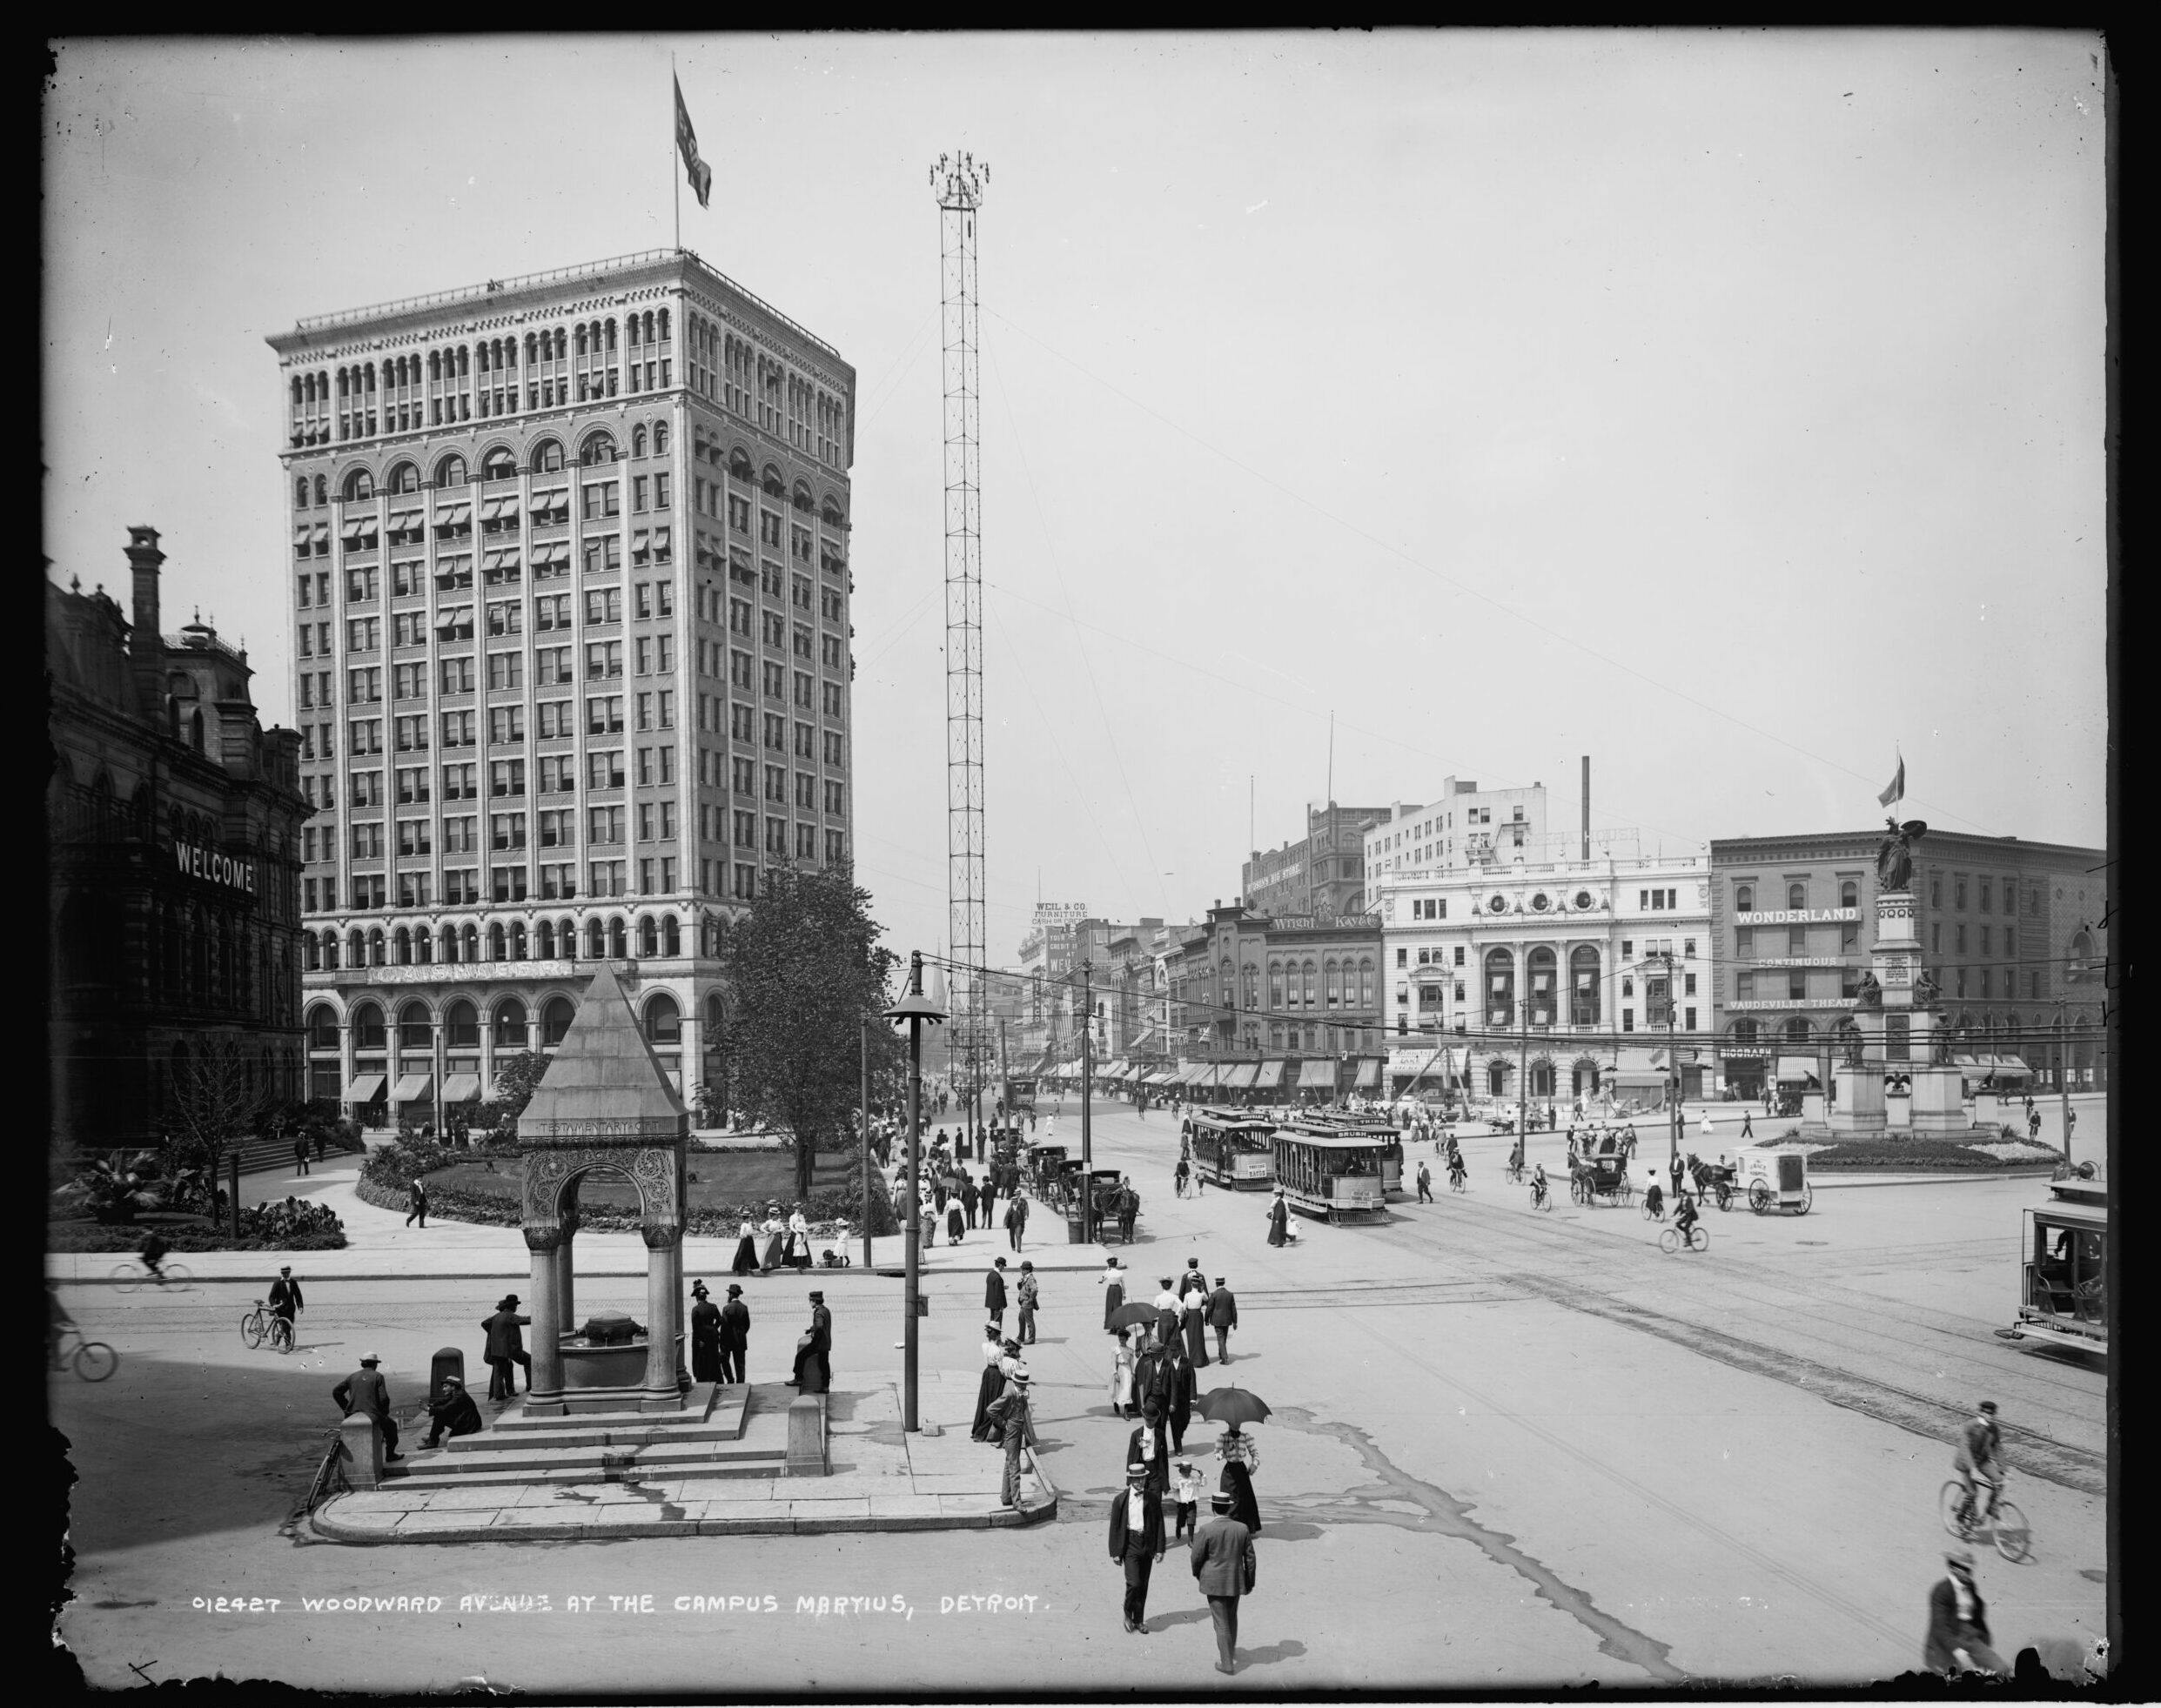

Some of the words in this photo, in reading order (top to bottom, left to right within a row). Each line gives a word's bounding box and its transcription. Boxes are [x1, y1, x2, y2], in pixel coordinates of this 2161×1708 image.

[175, 841, 253, 893] WELCOME
[1335, 916, 1358, 928] Kay
[1737, 908, 1856, 925] WONDERLAND
[1758, 956, 1837, 968] CONTINUOUS
[1730, 999, 1804, 1009] VAUDEVILLE
[1811, 998, 1858, 1008] THEATR
[1720, 1048, 1771, 1058] BIOGRAPH
[540, 1122, 628, 1132] TESTAMENTARY
